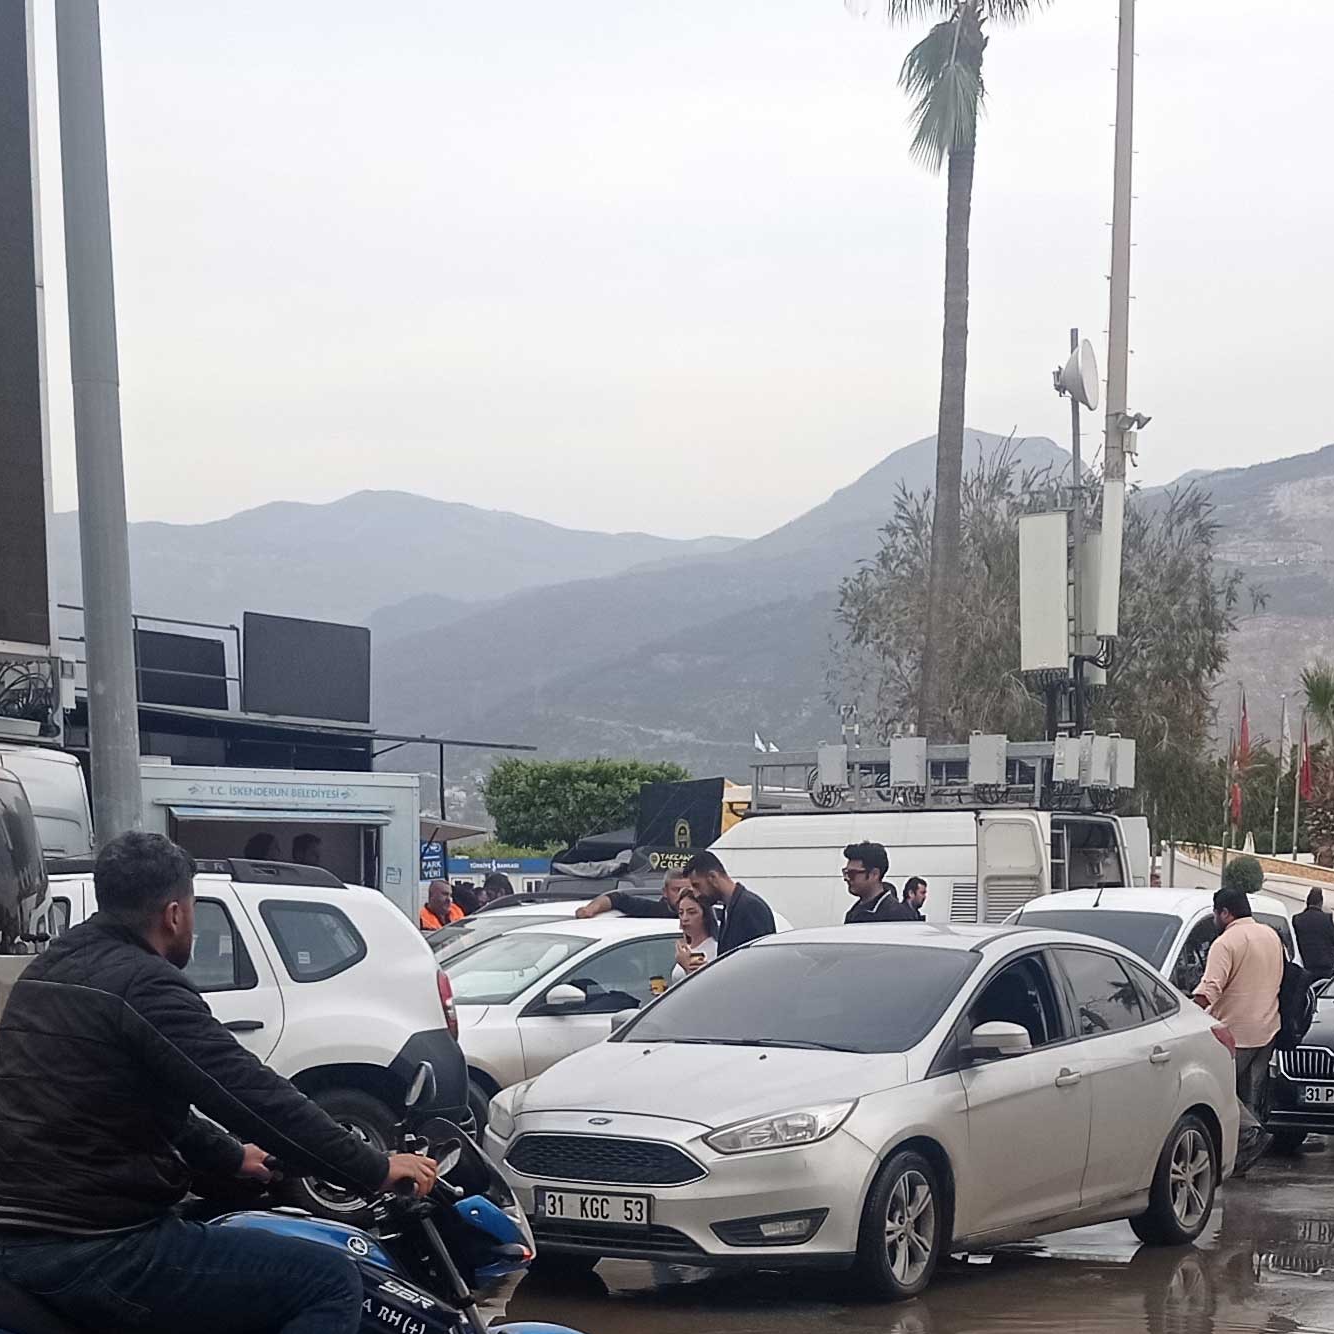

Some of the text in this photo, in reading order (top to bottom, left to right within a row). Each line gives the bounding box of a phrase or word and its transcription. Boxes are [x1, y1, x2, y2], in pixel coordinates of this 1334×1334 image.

[229, 784, 288, 797] İSKENDERUN
[291, 786, 339, 799] BELEDİYESİ
[1306, 1087, 1320, 1101] 31
[547, 1194, 644, 1222] 31 KGC 53
